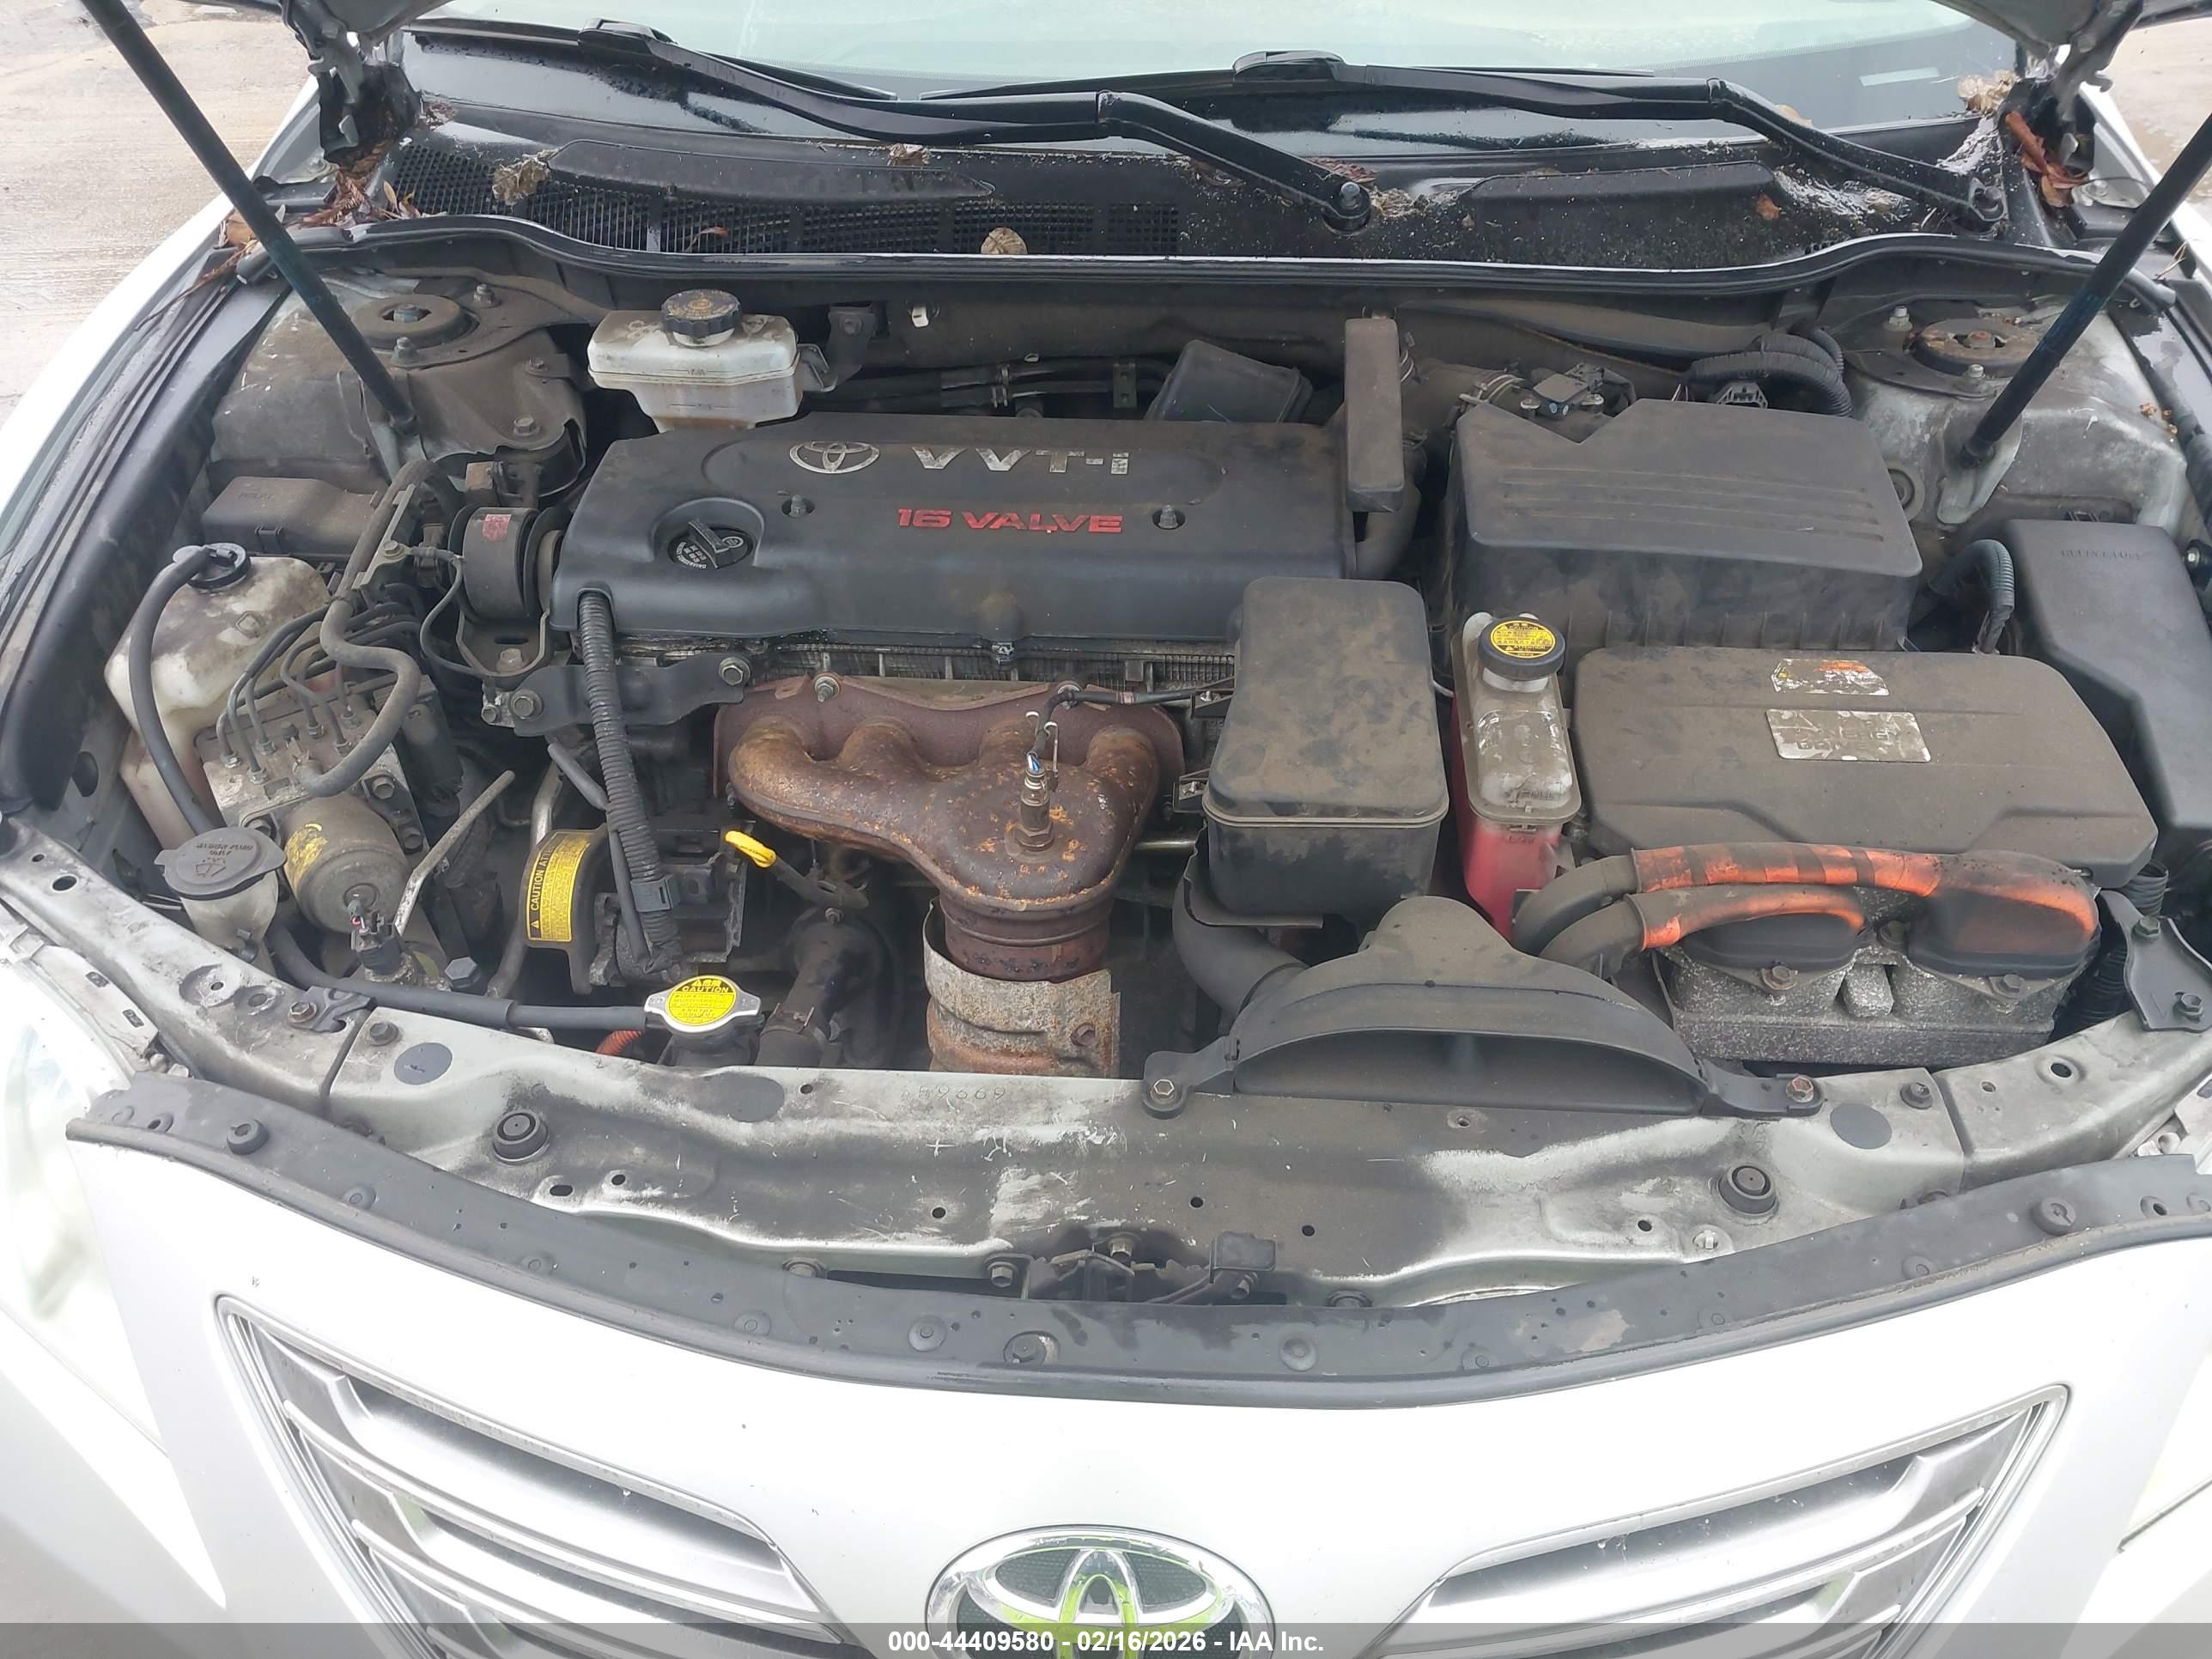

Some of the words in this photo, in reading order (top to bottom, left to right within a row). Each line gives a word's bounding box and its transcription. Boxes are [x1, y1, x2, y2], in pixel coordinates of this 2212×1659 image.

[912, 447, 1130, 474] VVT-i
[897, 507, 951, 528] 16
[962, 512, 1123, 533] VALVE
[531, 868, 544, 911] CAUTION
